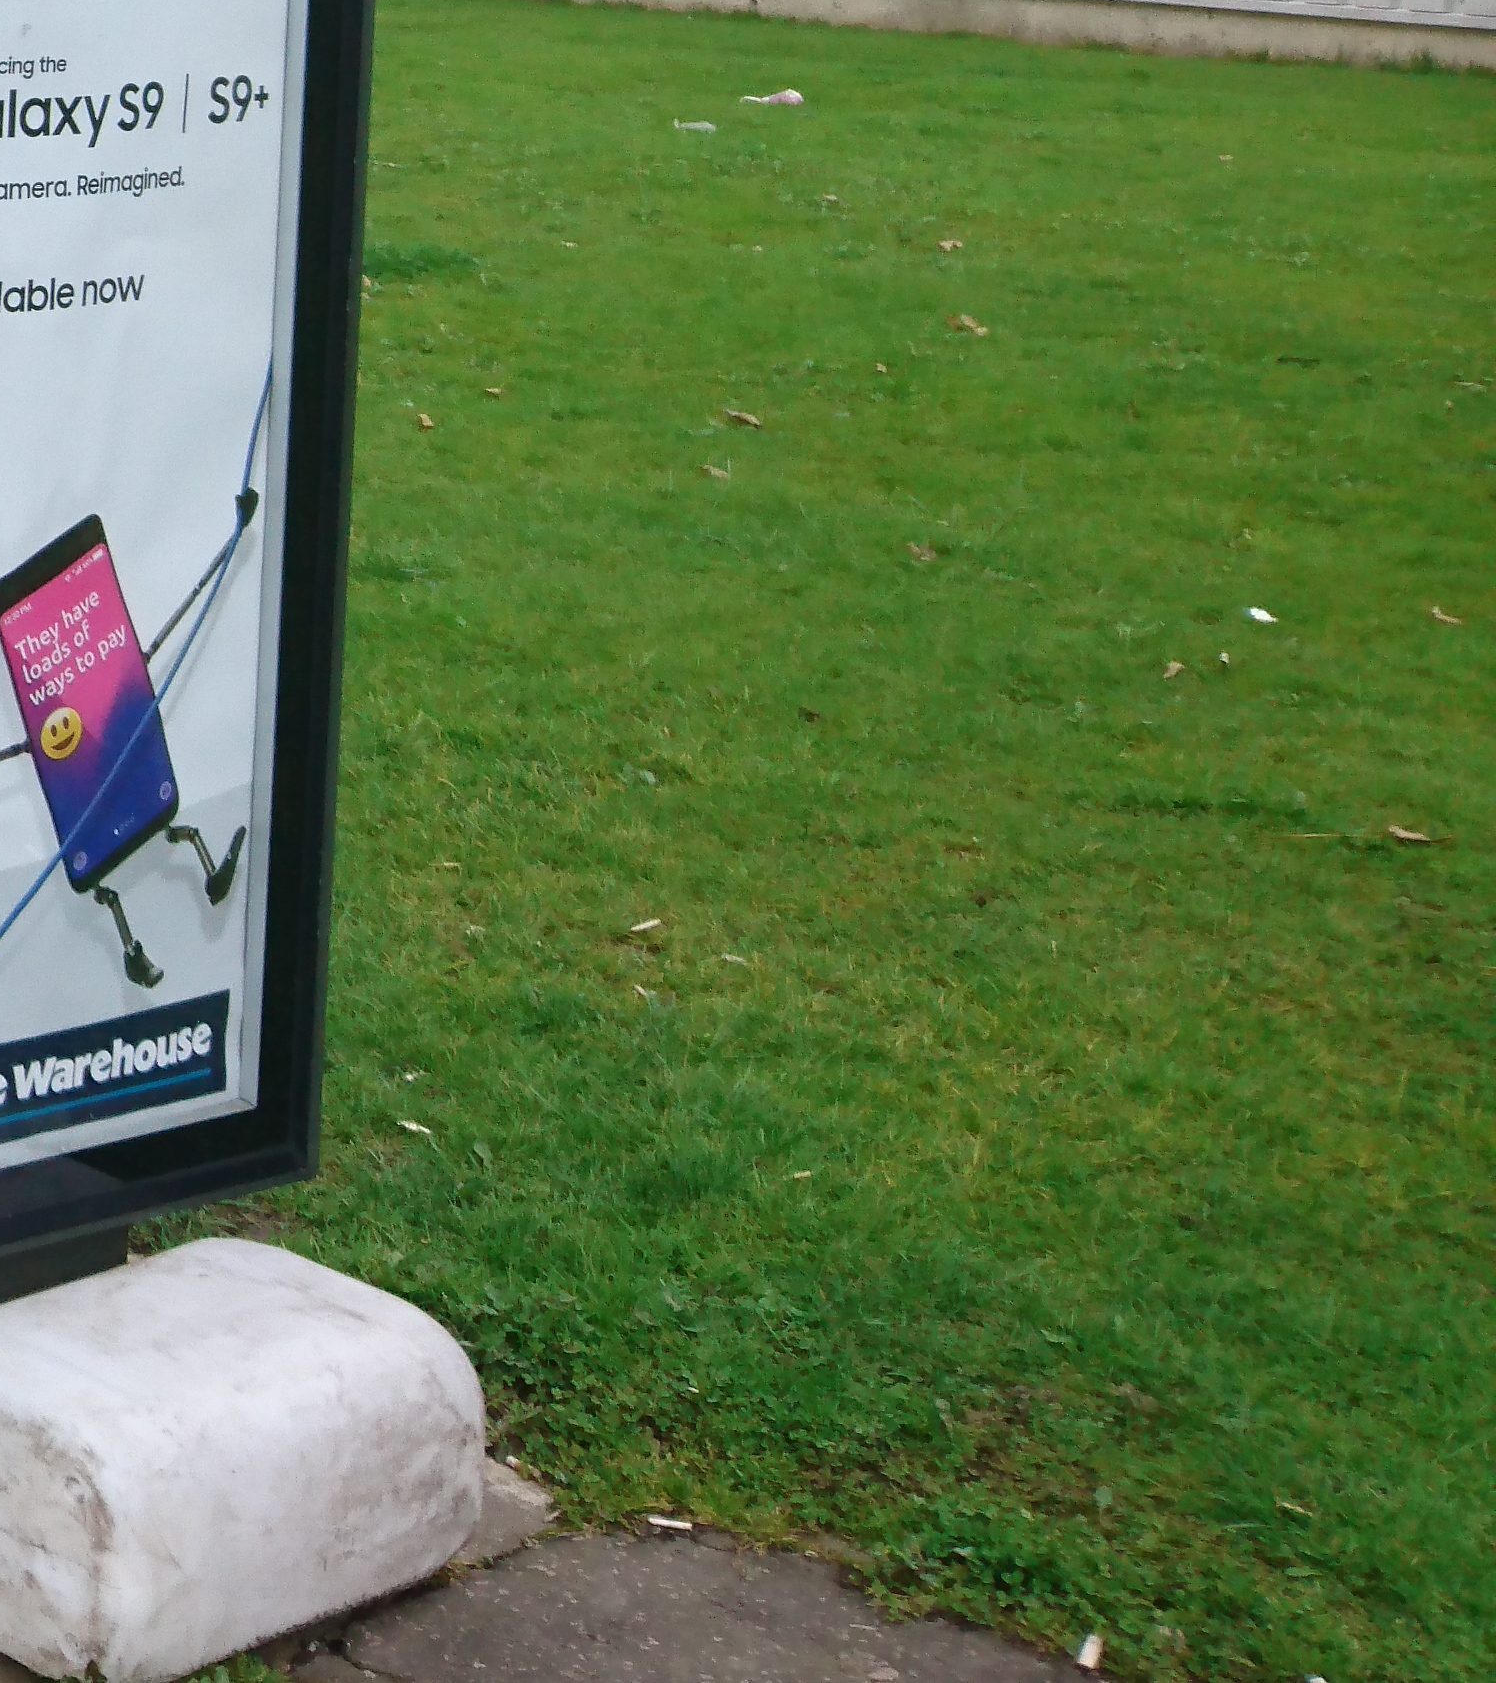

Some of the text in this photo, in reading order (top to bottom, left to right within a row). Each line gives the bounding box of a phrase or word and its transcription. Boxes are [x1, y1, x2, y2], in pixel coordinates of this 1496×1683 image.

[39, 55, 68, 73] the
[117, 81, 165, 132] S9
[207, 74, 270, 125] S9+
[77, 165, 186, 198] Reimagined.
[81, 274, 145, 308] now
[14, 591, 101, 661] They have
[20, 602, 33, 616] PM
[21, 618, 91, 685] loads of
[28, 624, 126, 707] ways to pay
[12, 1022, 212, 1102] Warehouse
